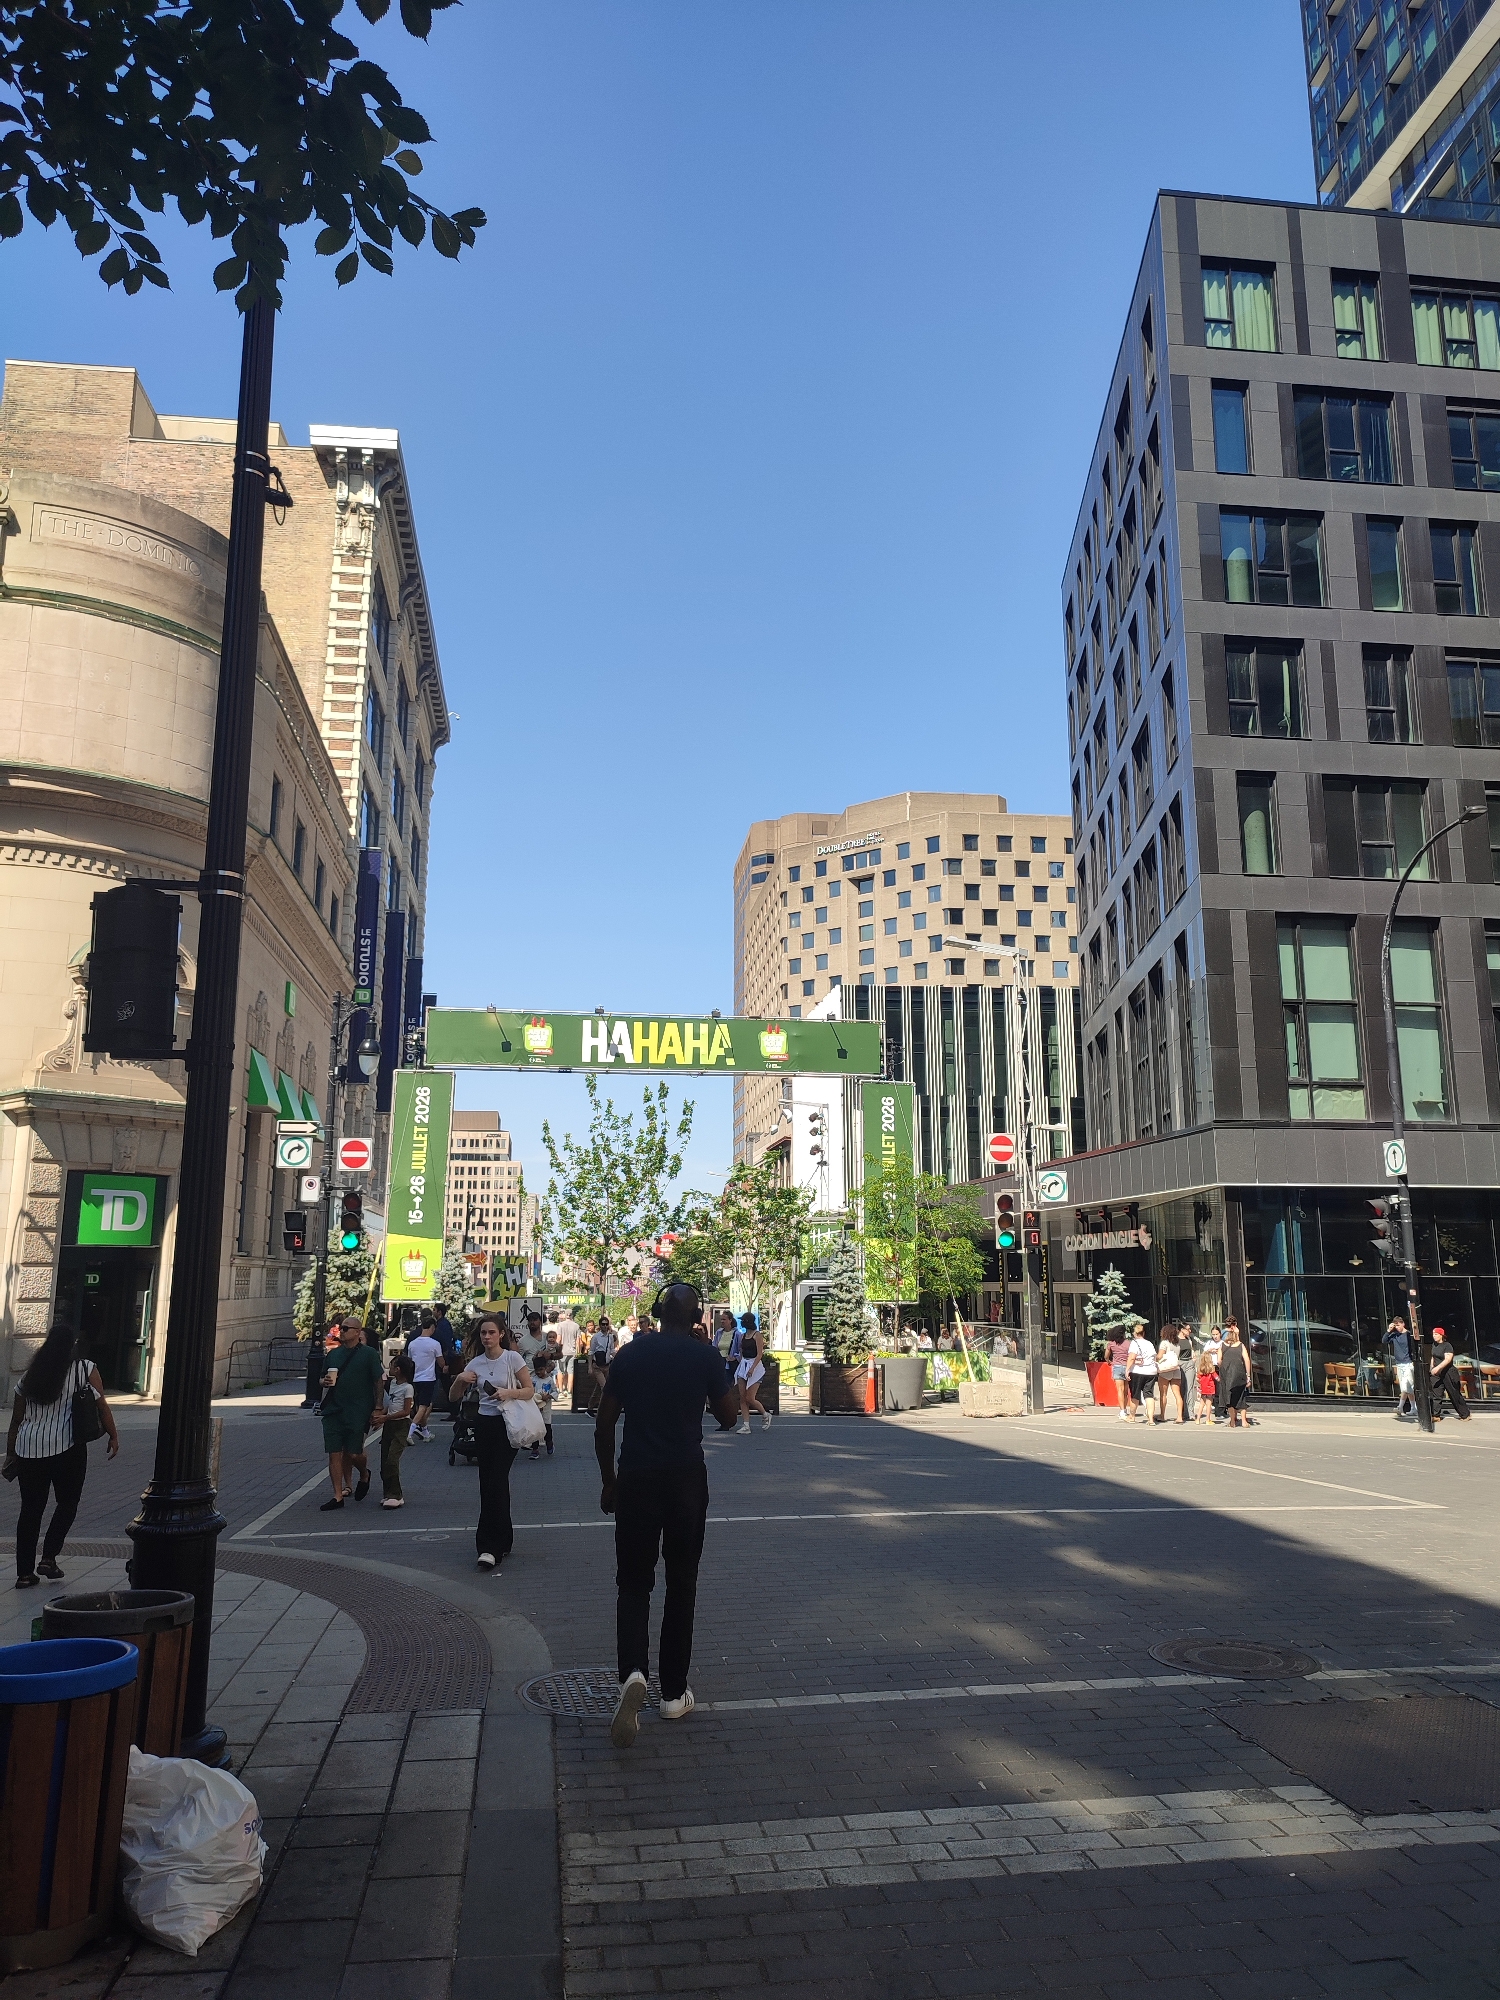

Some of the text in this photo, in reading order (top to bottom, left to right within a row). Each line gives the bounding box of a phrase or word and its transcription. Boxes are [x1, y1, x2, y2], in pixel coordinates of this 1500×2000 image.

[48, 516, 209, 580] THE DOMINIO
[358, 928, 372, 986] LE STUDIO
[356, 990, 370, 1001] TD
[581, 1019, 735, 1066] HAHAHA
[881, 1096, 895, 1132] 2026
[408, 1086, 431, 1225] 15 26 JUILLET 2026
[881, 1133, 896, 1172] ILLET
[90, 1188, 148, 1232] TD
[1064, 1229, 1140, 1252] COCHON DINGUE
[84, 1273, 100, 1284] TD
